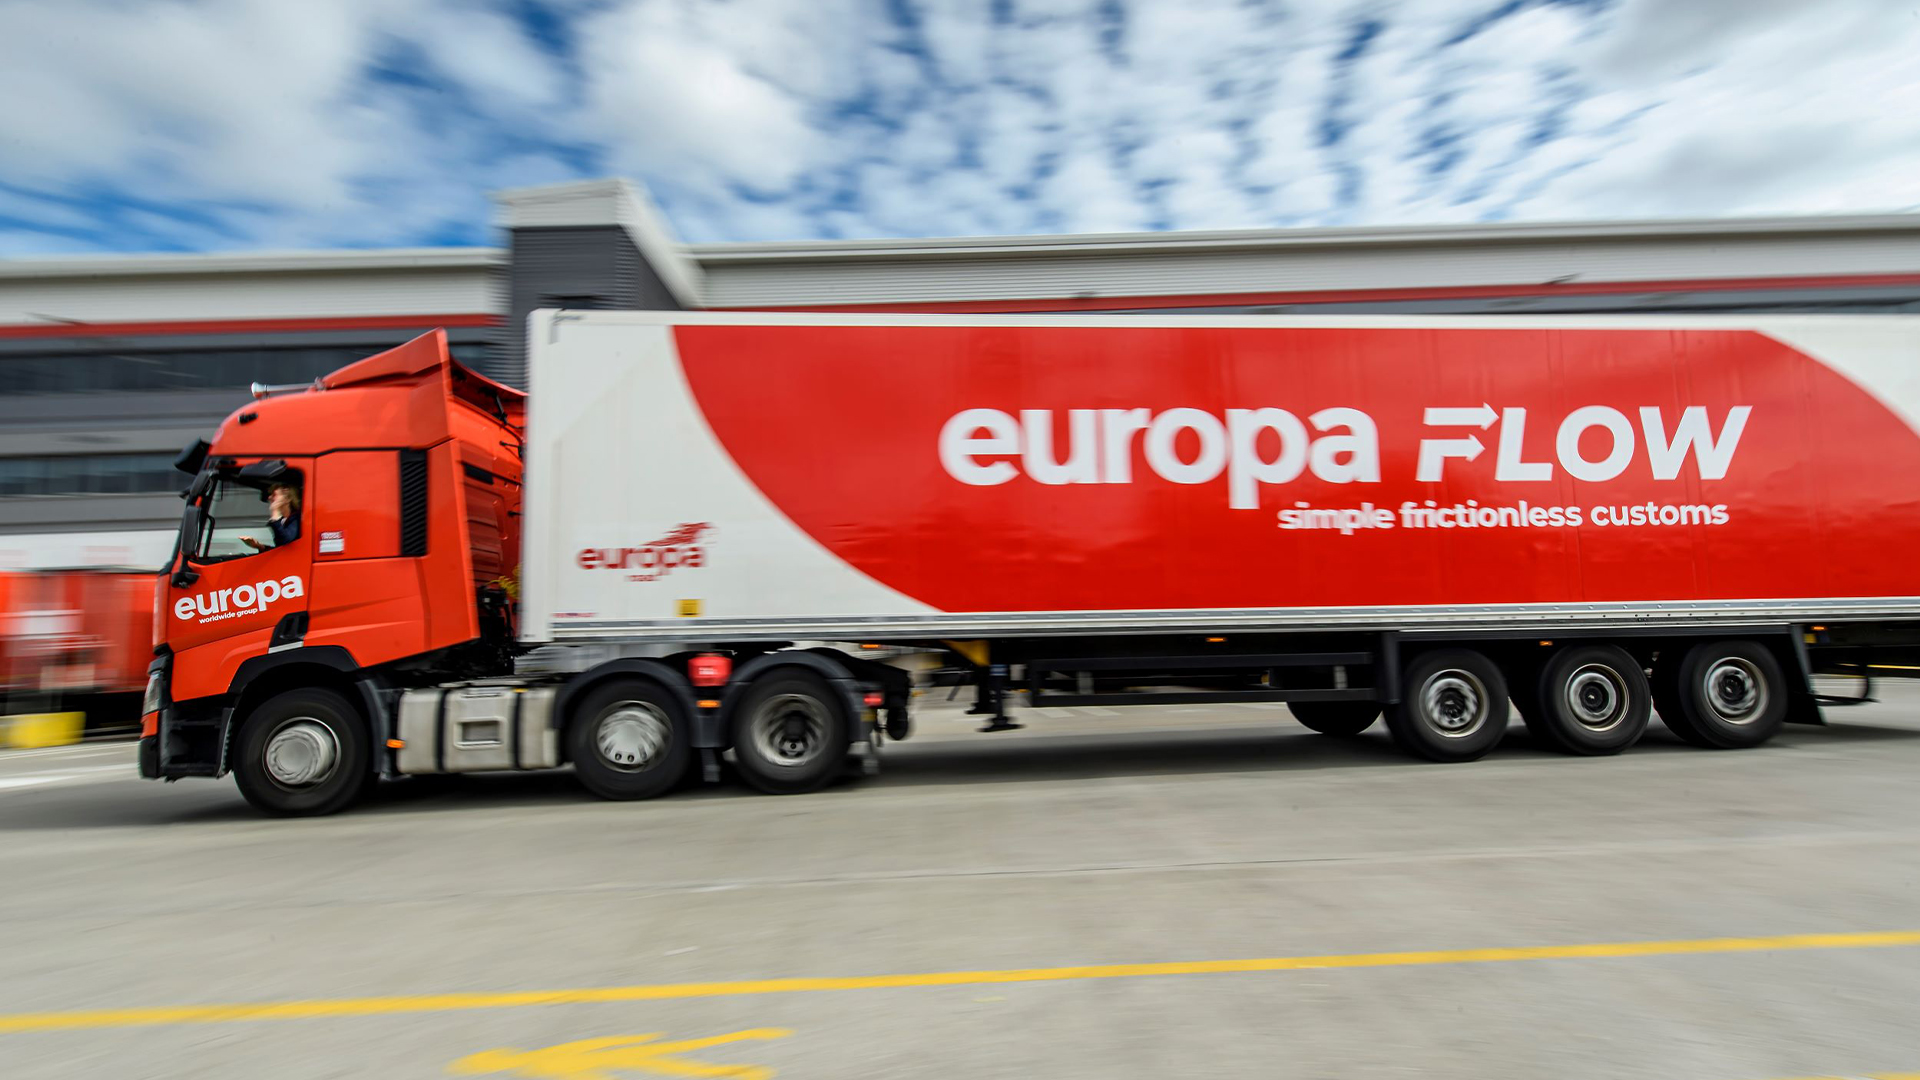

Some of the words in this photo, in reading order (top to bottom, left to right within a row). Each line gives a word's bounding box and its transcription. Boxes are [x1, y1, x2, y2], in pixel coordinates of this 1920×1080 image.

[938, 407, 1381, 509] europa
[1416, 402, 1753, 482] FLOW
[1277, 501, 1396, 535] simple
[1400, 500, 1583, 528] frictionless
[1590, 501, 1730, 526] customs
[577, 547, 707, 575] europa
[174, 575, 304, 620] europa
[199, 610, 235, 624] worldwide
[236, 607, 258, 618] group
